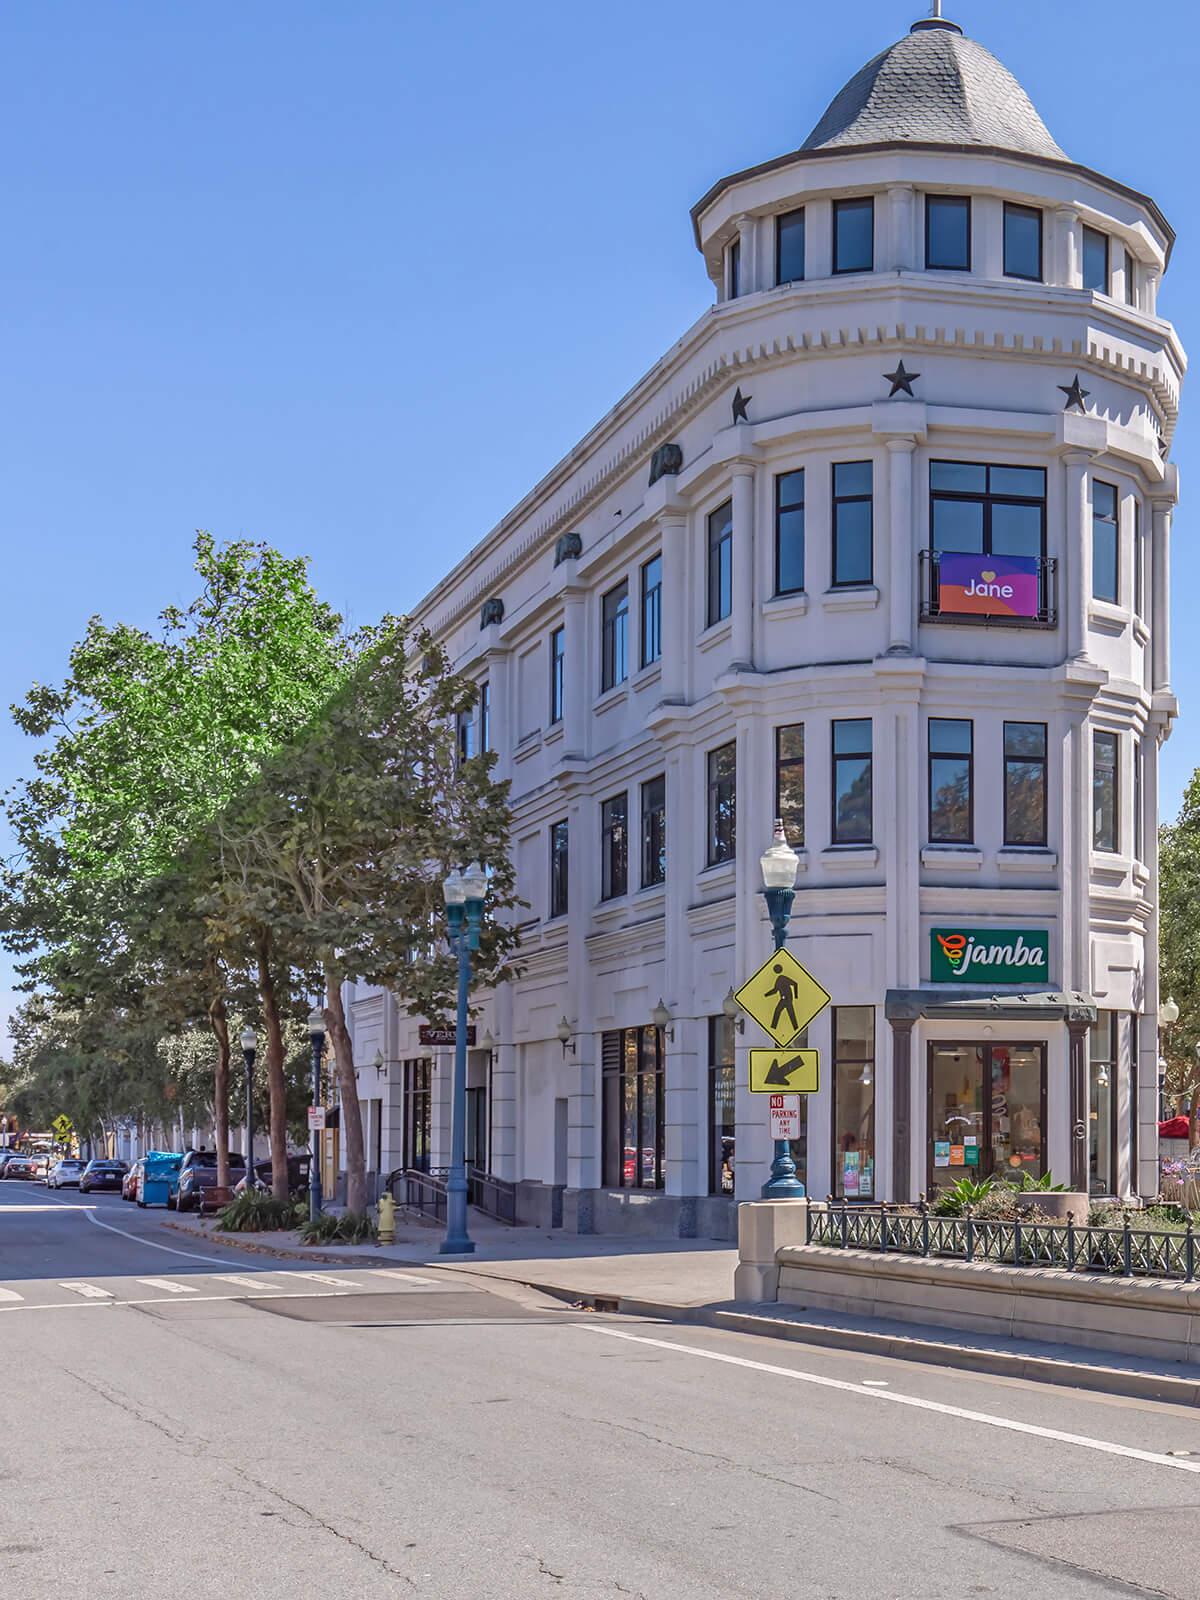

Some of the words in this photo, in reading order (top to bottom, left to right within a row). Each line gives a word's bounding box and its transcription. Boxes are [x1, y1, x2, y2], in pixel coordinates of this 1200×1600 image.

[964, 578, 1014, 598] Jane
[952, 936, 1046, 975] jamba
[771, 1096, 783, 1108] NO
[772, 1110, 798, 1119] PARKING
[779, 1127, 791, 1135] TIME
